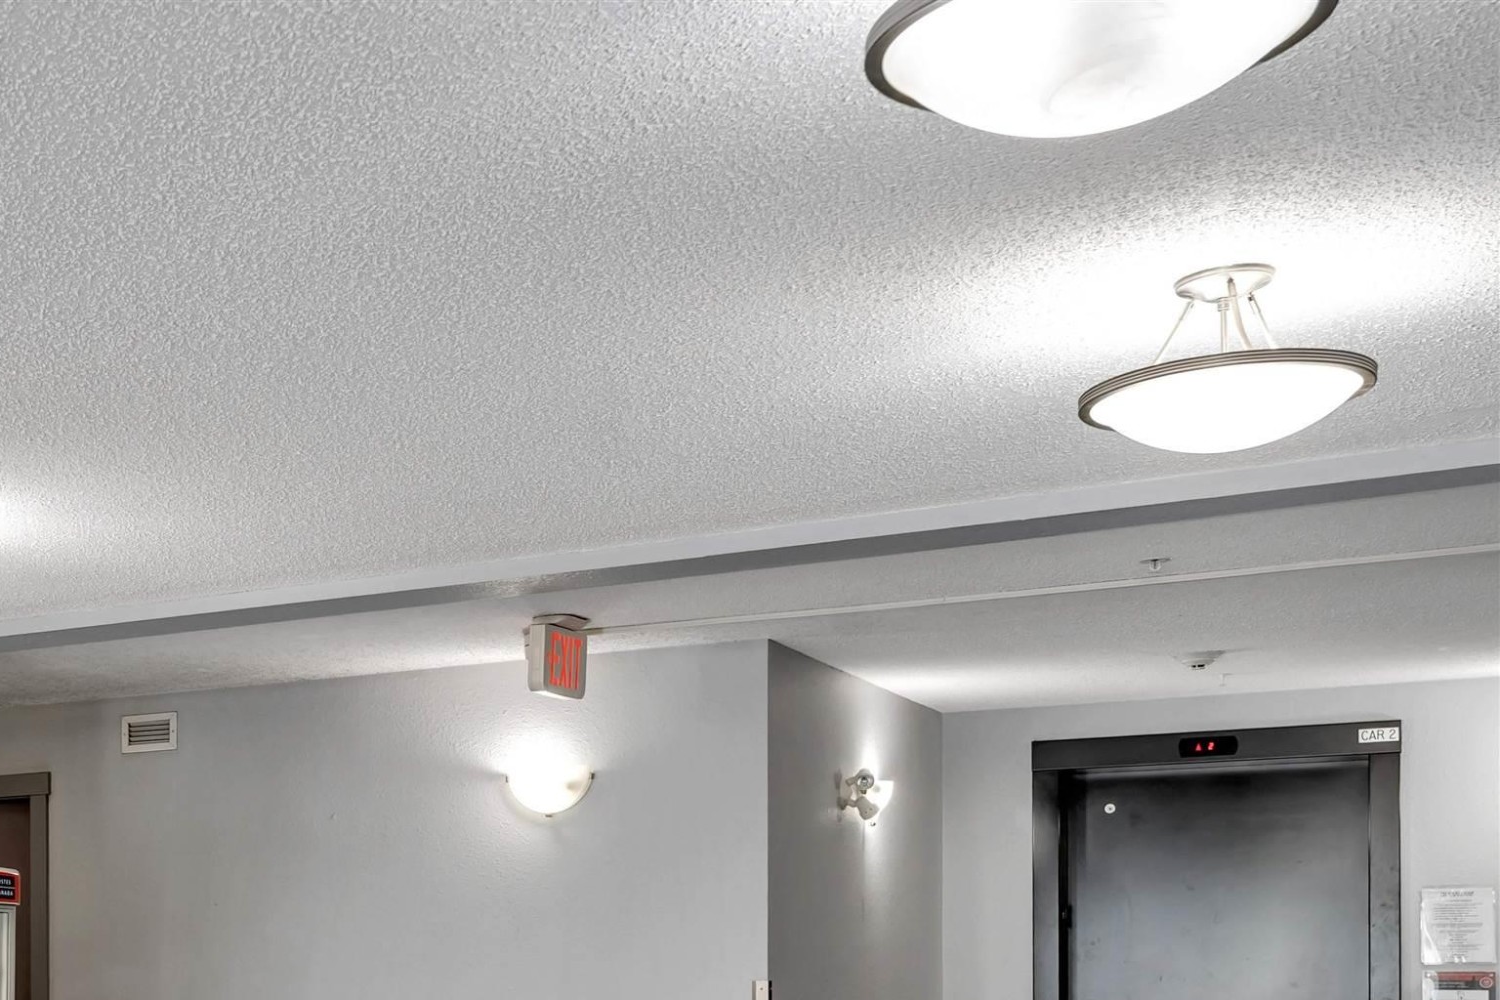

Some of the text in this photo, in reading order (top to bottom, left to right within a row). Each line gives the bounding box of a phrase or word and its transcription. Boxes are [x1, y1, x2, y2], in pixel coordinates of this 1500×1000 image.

[548, 631, 583, 690] EXIT
[1361, 729, 1396, 741] CAR 2
